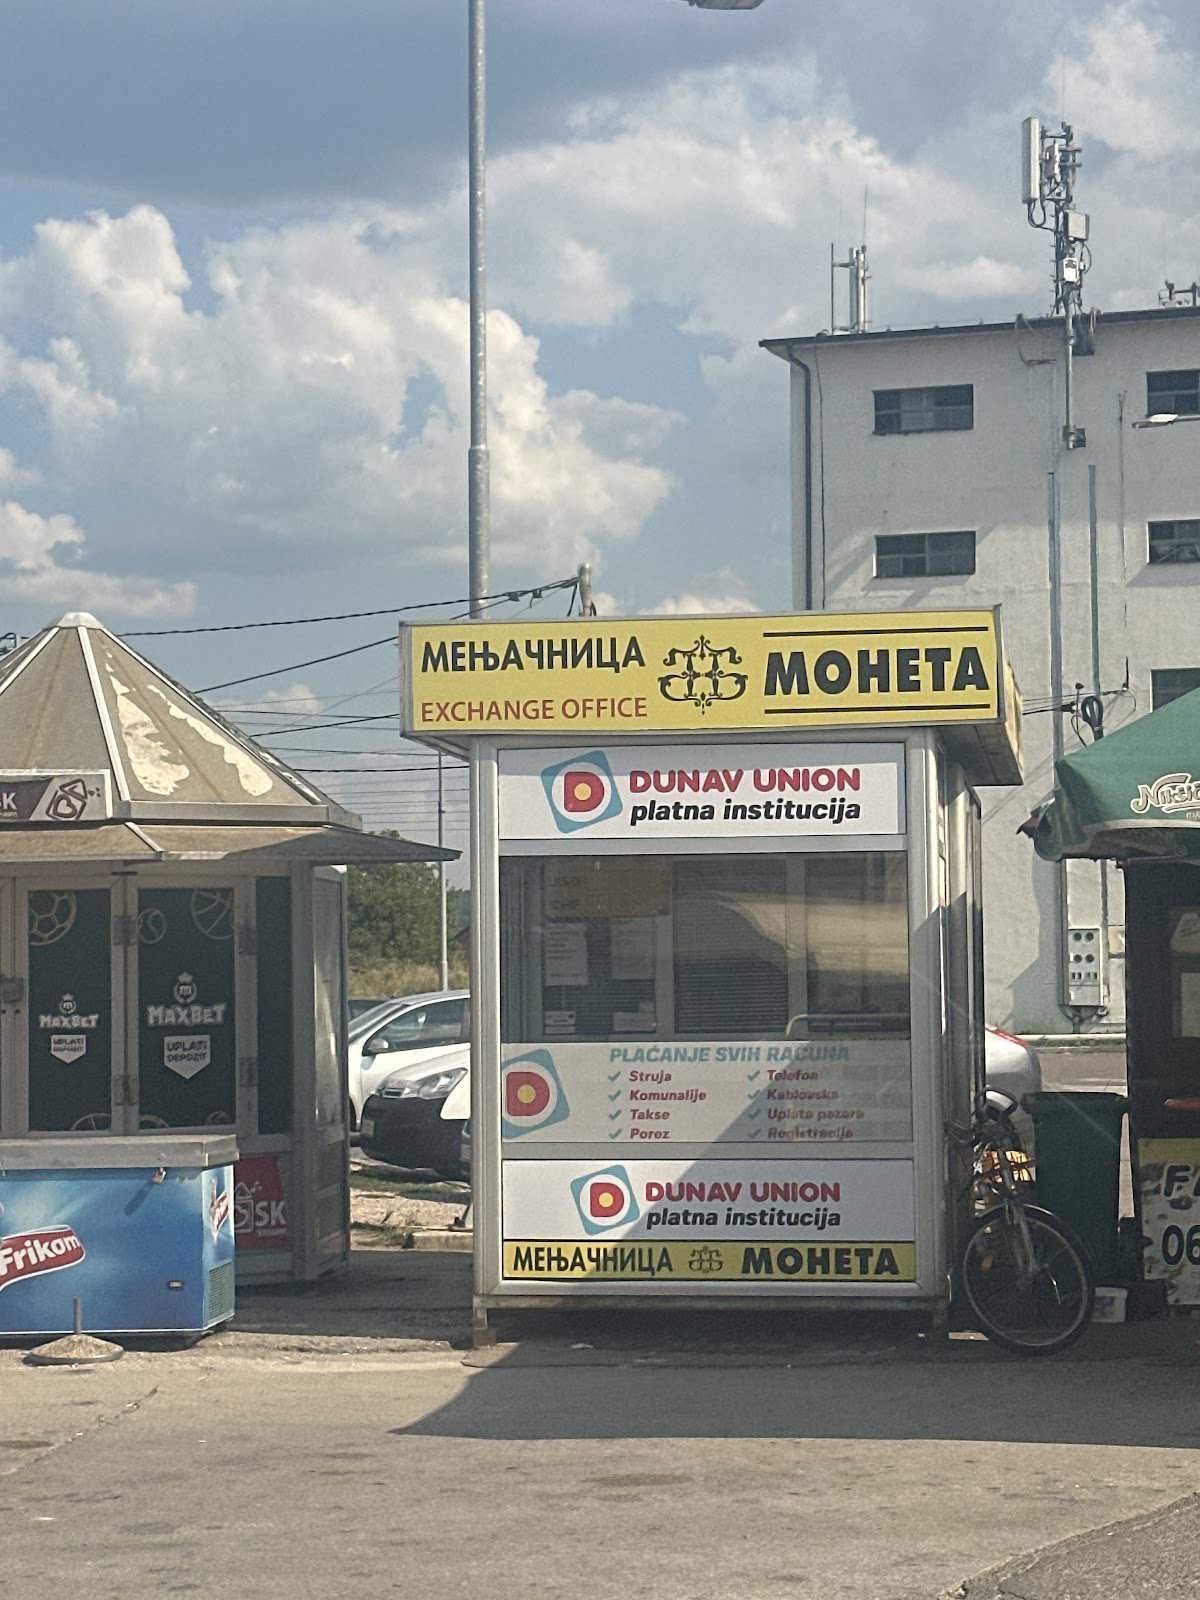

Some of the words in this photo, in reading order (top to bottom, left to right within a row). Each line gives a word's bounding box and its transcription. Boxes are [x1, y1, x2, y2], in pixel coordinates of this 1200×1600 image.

[421, 636, 646, 674] МЕЊАЧНИЦА
[763, 646, 990, 696] МОНЕТА
[421, 700, 554, 722] EXCHANGE
[561, 697, 648, 719] OFFICE
[629, 768, 742, 794] DUNAV
[753, 767, 861, 793] UNION
[630, 800, 716, 826] platna
[723, 798, 861, 824] institucija
[167, 1040, 207, 1052] UPLATI
[609, 1044, 710, 1063] PLAĆANJE
[715, 1046, 760, 1062] SVIH
[629, 1070, 672, 1084] Struja
[767, 1069, 819, 1081] Telefon
[629, 1089, 707, 1103] Komunalije
[630, 1108, 670, 1120] Takse
[767, 1108, 813, 1121] Uplata
[630, 1128, 670, 1140] Porez
[646, 1182, 742, 1202] DUNAV
[750, 1182, 840, 1202] UNION
[646, 1209, 718, 1229] platna
[725, 1207, 841, 1230] institucija
[0, 1235, 81, 1276] Frikom
[513, 1246, 673, 1276] МЕЊАЧНИЦА
[741, 1247, 900, 1275] МОНЕТА
